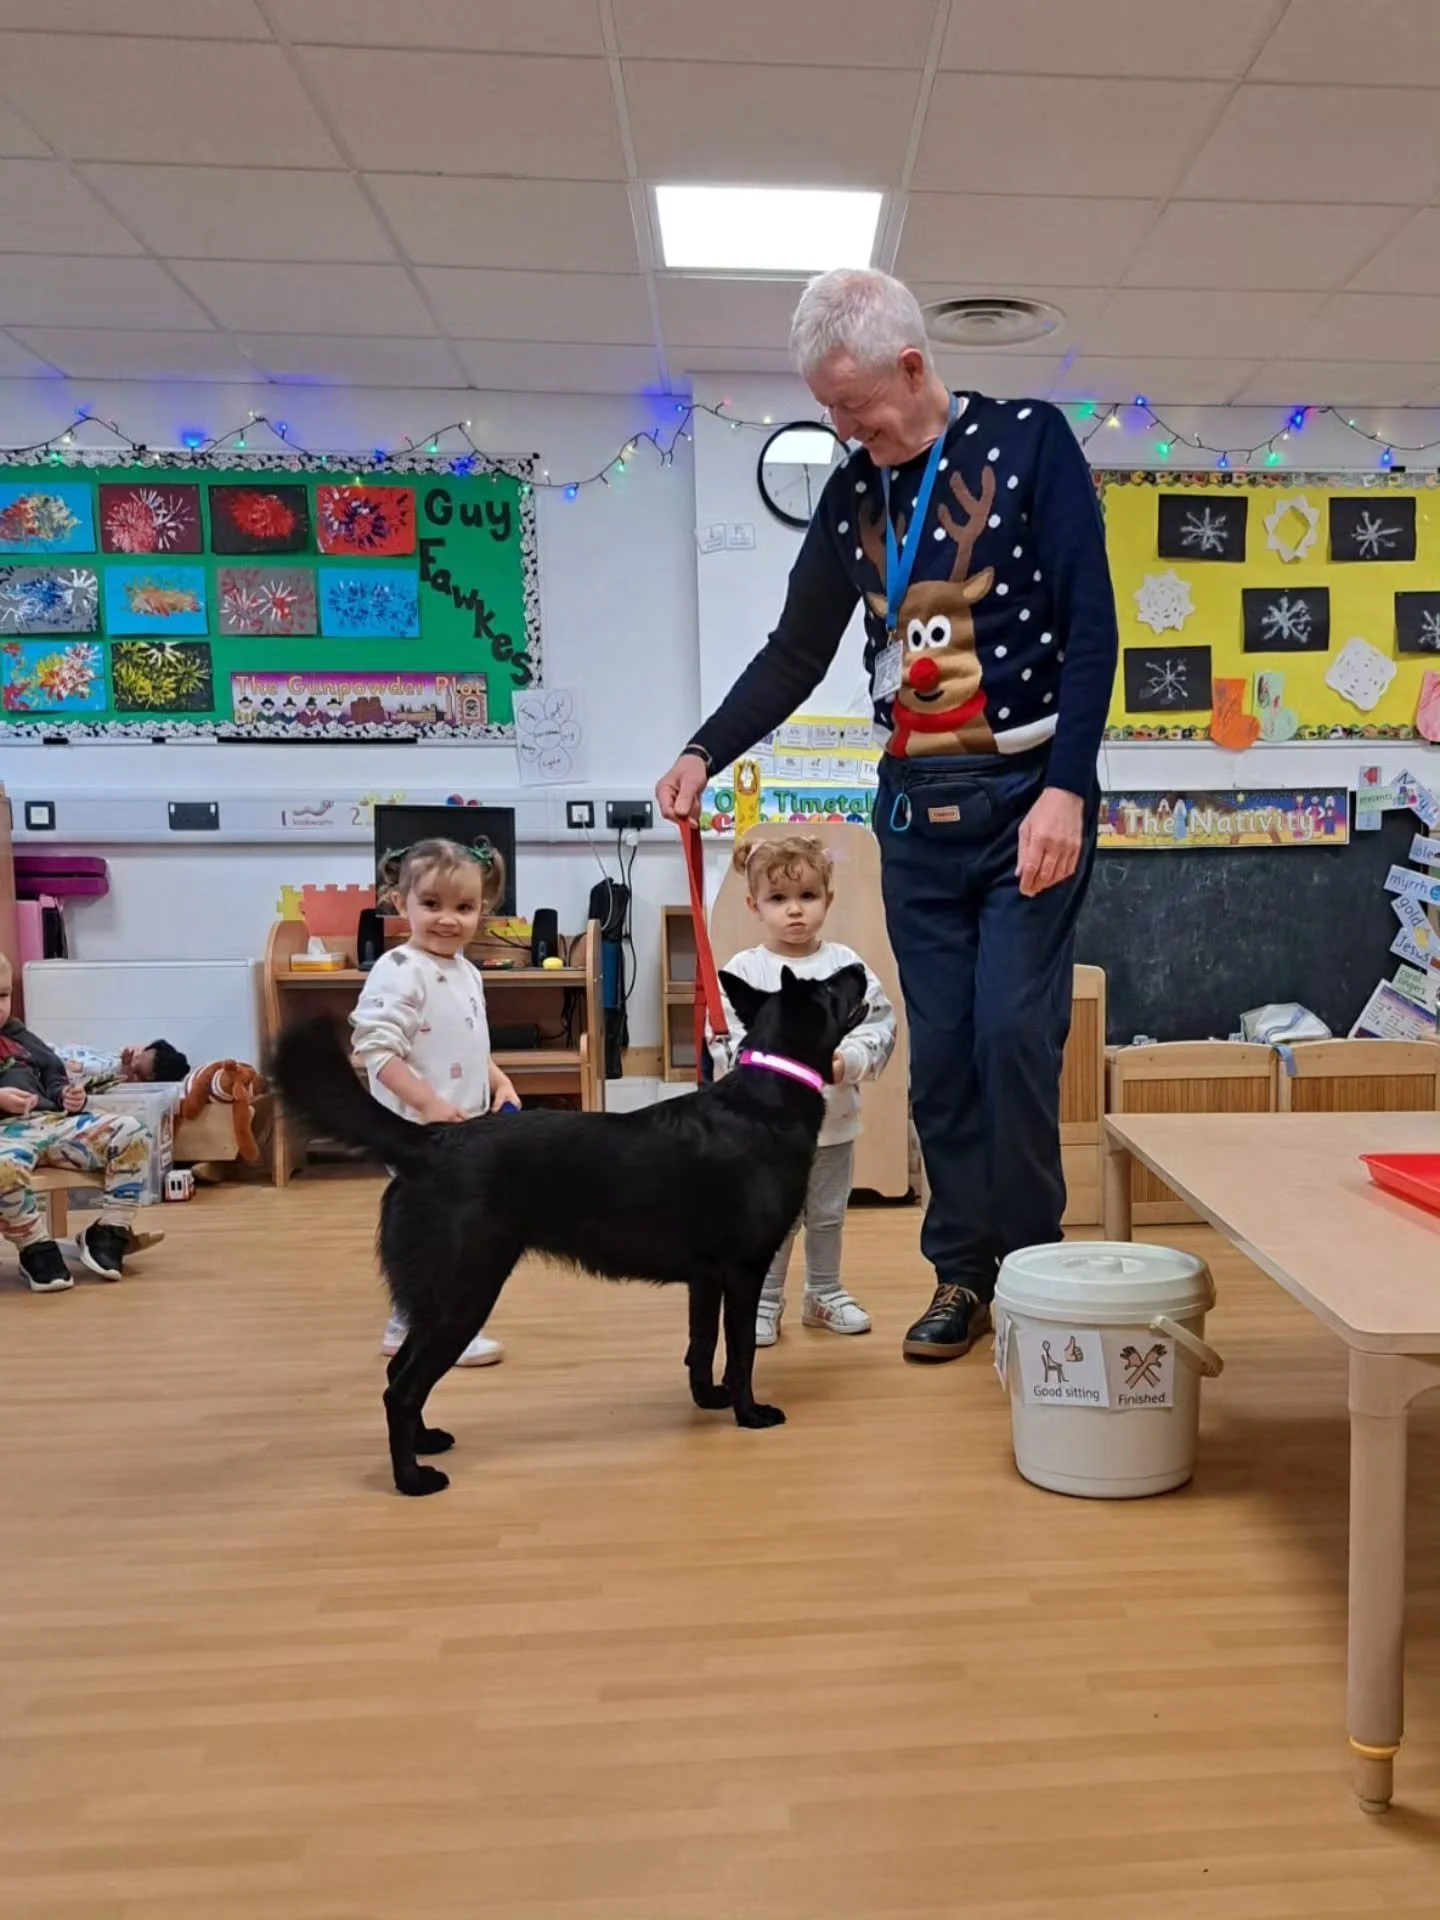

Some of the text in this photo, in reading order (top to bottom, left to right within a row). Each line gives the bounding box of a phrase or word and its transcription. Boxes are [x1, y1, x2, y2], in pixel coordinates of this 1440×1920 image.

[424, 488, 511, 541] Guy
[419, 538, 533, 685] Fawkes
[236, 674, 483, 702] The Gunpowder Plot
[351, 806, 362, 826] 2
[1124, 806, 1315, 841] The Nativity
[1390, 875, 1428, 894] myrrh
[1396, 896, 1425, 928] gold
[1395, 935, 1431, 963] Jesus
[1399, 969, 1422, 984] carol
[1033, 1385, 1100, 1402] Good sitting
[1118, 1392, 1166, 1406] Finished
